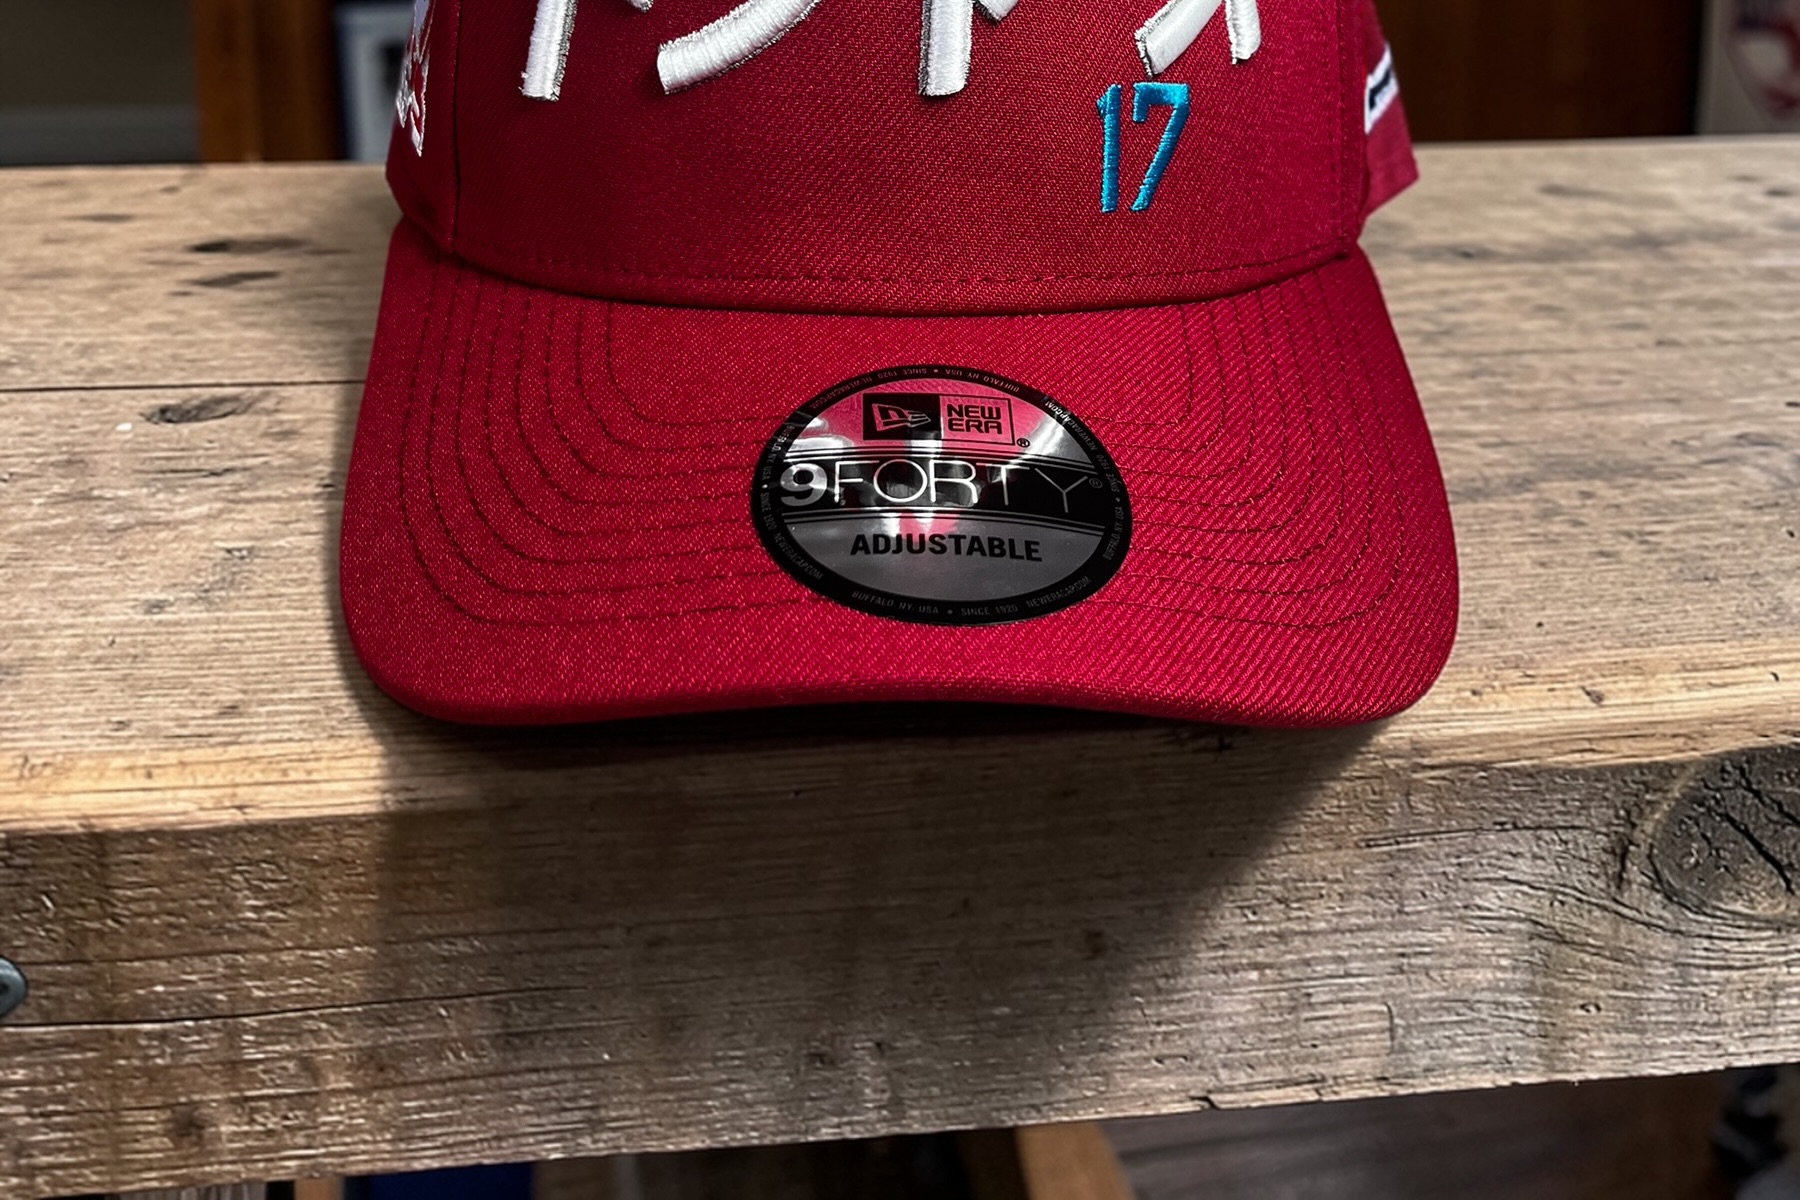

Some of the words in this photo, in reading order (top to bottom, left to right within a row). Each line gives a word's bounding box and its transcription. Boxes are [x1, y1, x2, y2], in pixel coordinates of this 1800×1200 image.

[1095, 81, 1190, 214] 17
[877, 369, 898, 379] 1920
[946, 403, 1001, 420] NEW
[947, 418, 1003, 435] ERA
[1096, 454, 1111, 471] 1920
[780, 458, 1088, 514] 9FORTY
[1105, 473, 1120, 494] SINCE
[760, 492, 772, 513] SINCE
[763, 514, 777, 531] 1920
[850, 533, 1043, 563] ADJUSTABLE
[918, 605, 939, 615] USA
[961, 606, 991, 616] SINCE
[995, 604, 1019, 614] 1920
